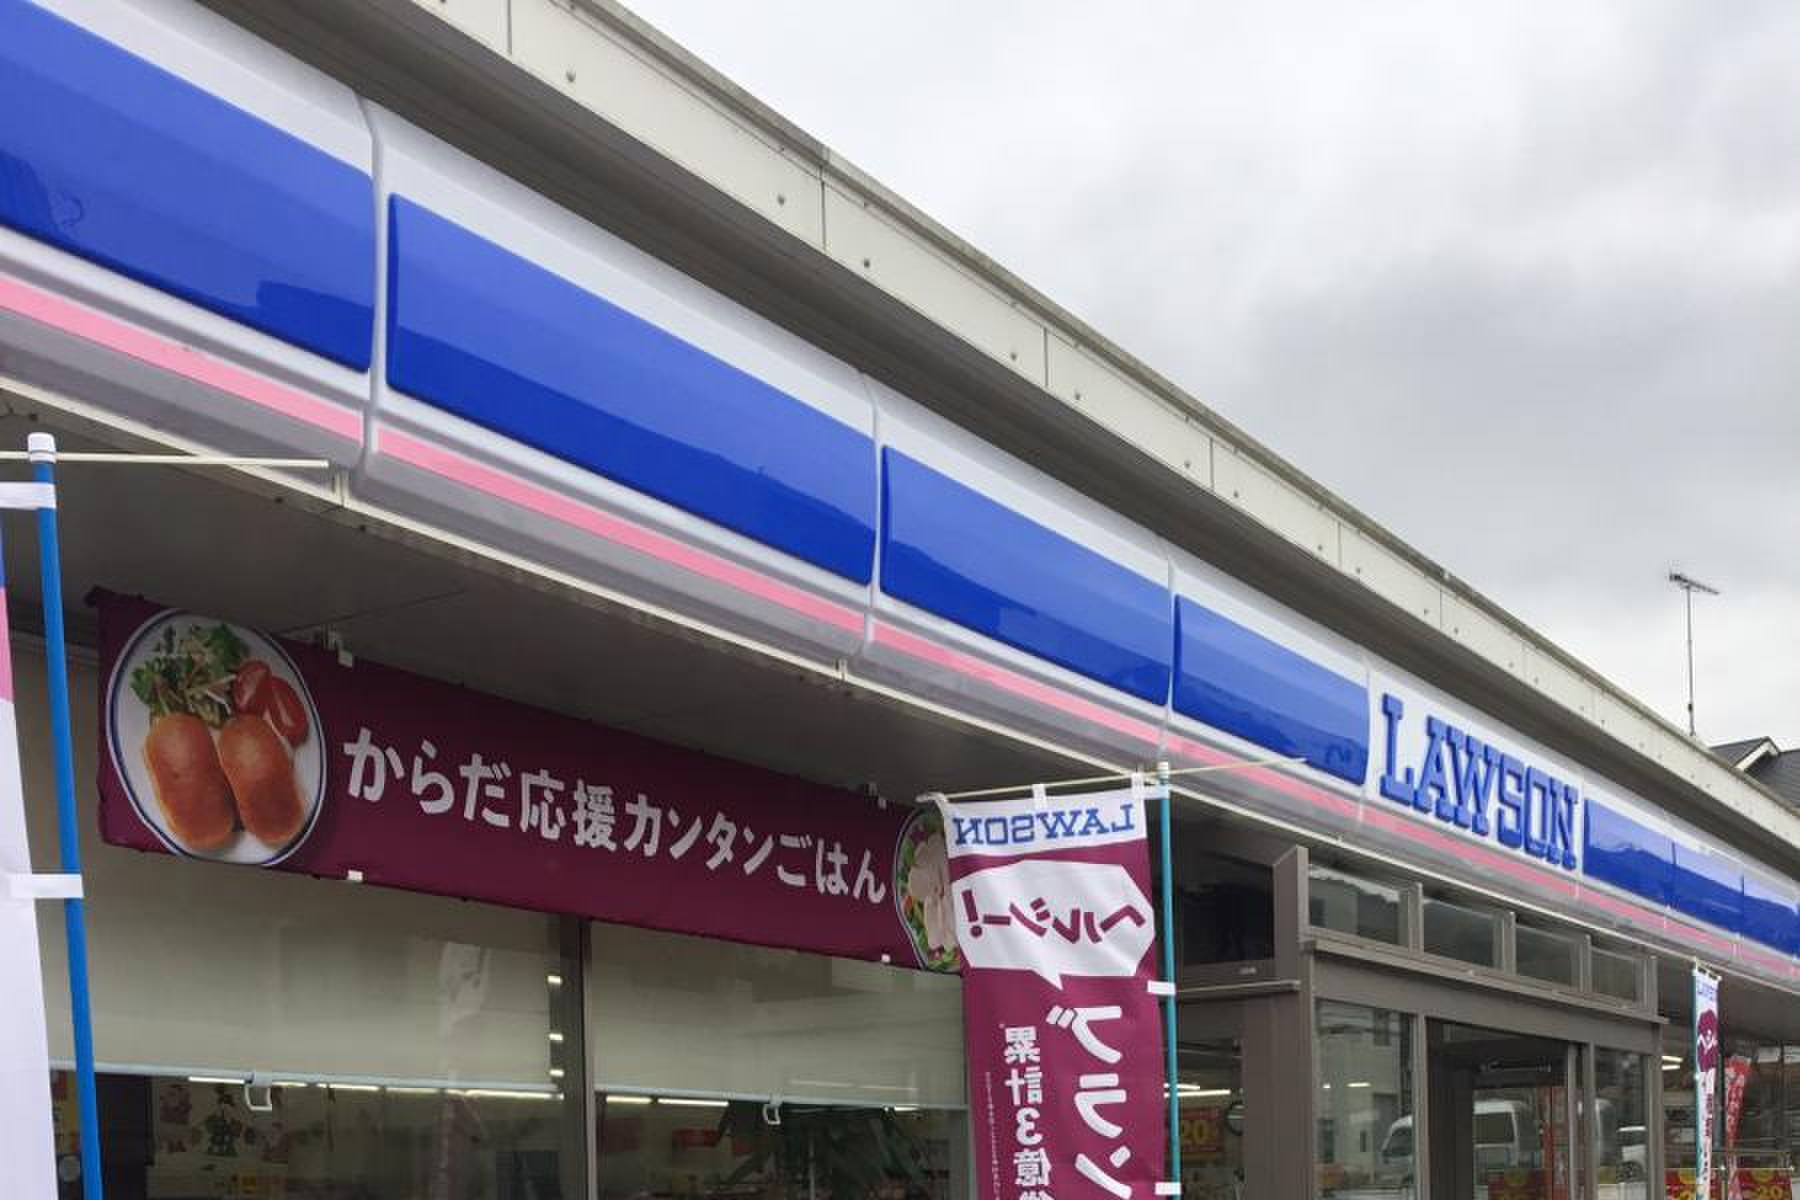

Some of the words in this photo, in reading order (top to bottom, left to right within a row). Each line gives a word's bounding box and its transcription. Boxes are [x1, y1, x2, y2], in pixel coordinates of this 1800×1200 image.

[344, 727, 886, 904] からだ応援カンタンごはん
[1379, 693, 1579, 870] LAWSON
